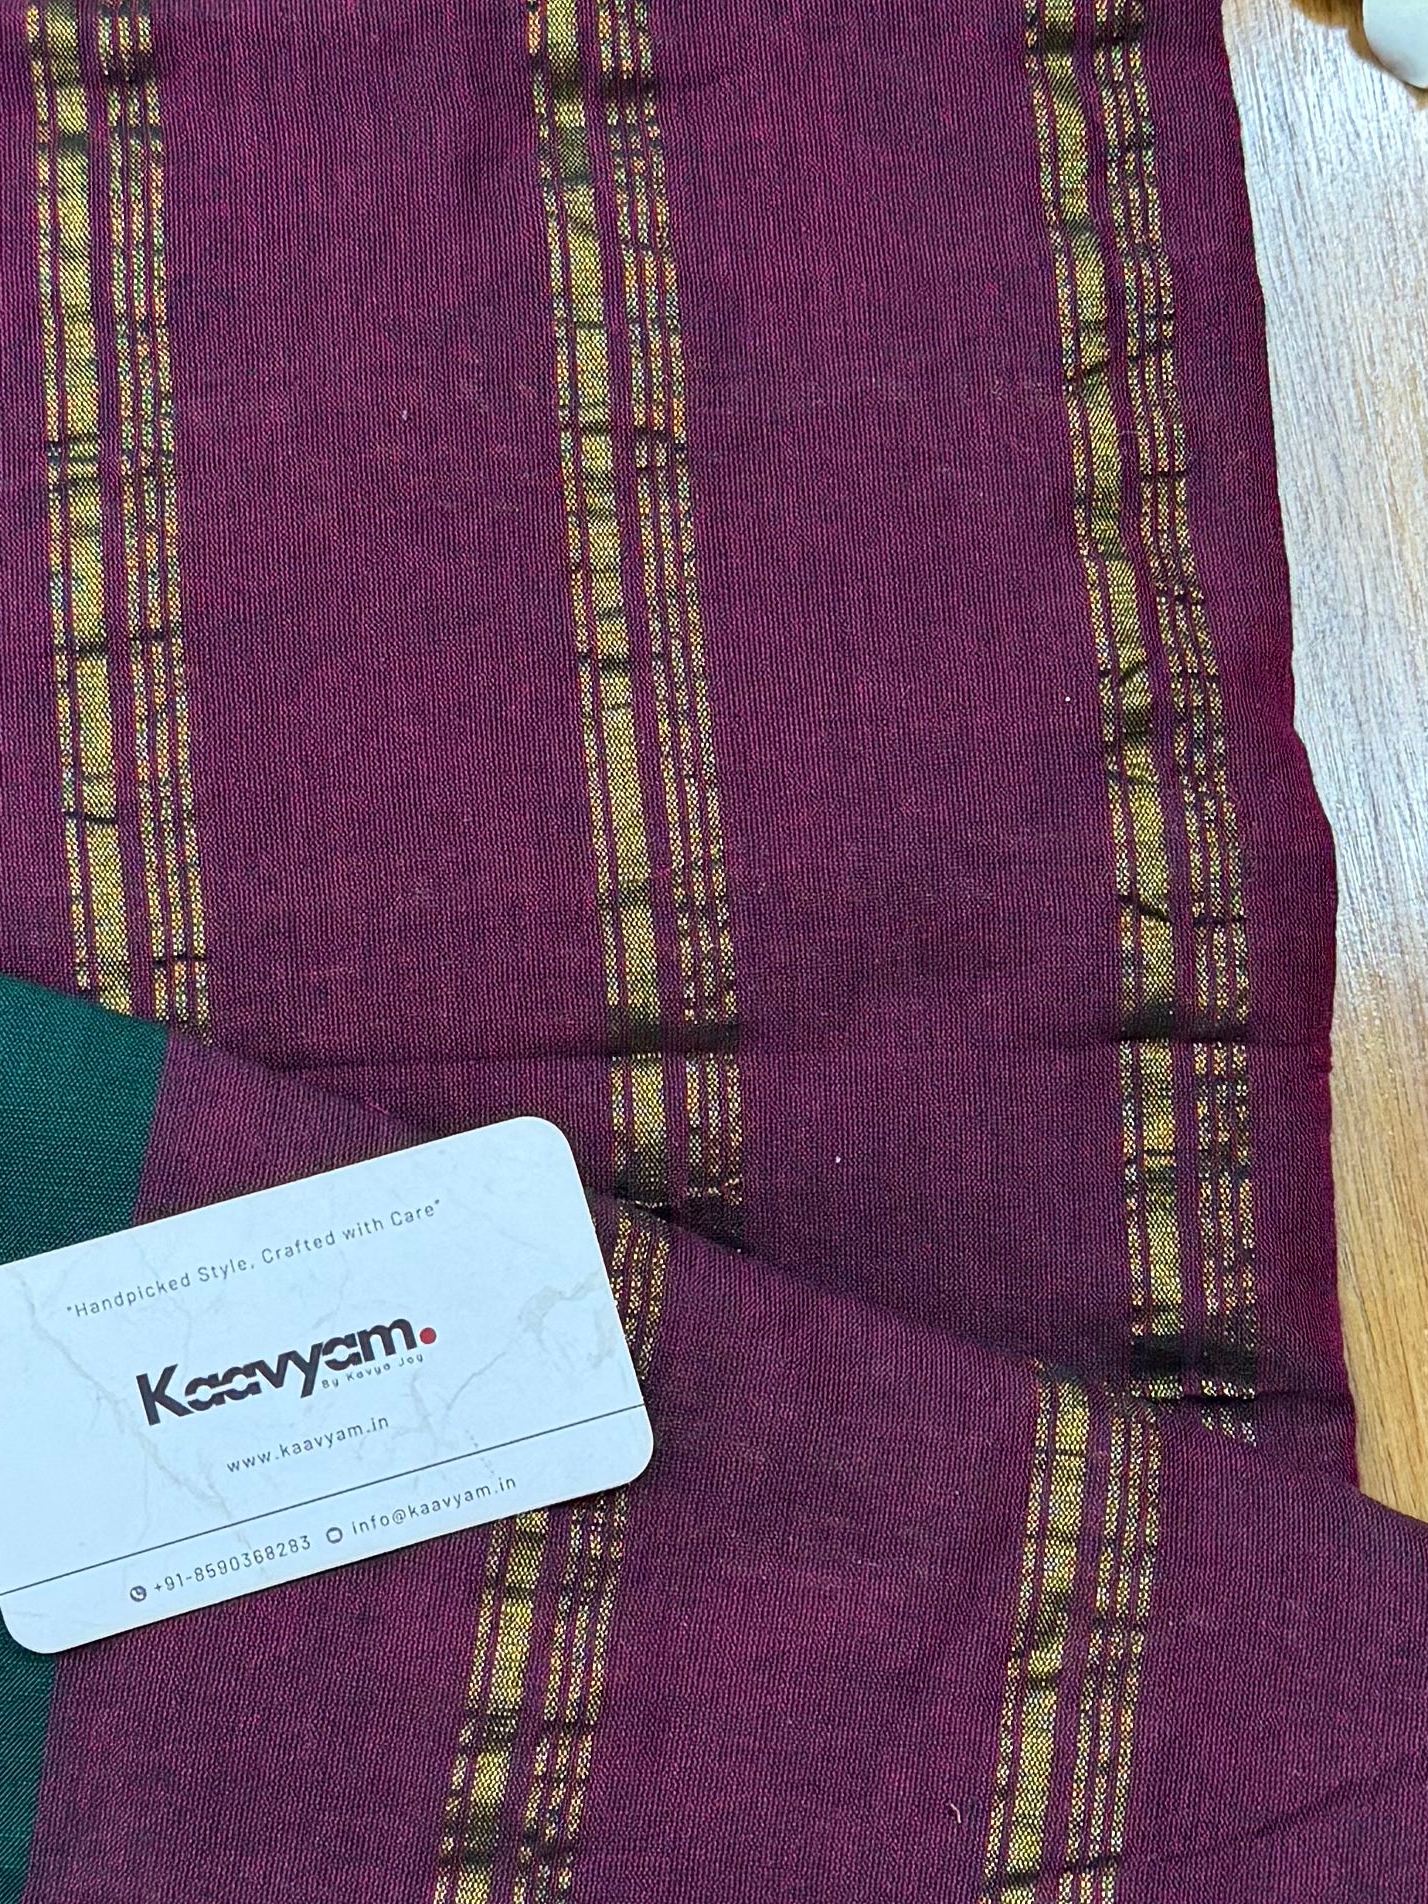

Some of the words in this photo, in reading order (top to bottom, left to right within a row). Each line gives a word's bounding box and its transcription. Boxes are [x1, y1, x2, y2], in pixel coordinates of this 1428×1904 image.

[197, 1258, 254, 1283] Style,
[261, 1230, 336, 1264] Crafted
[341, 1218, 385, 1241] with
[321, 1378, 340, 1389] By
[346, 1362, 391, 1382] Kavya
[398, 1353, 424, 1367] Joy
[226, 1416, 390, 1473] www.kaavyam.in
[154, 1534, 311, 1592] +91-8590368283
[351, 1476, 517, 1535] info@kaavyam.in
